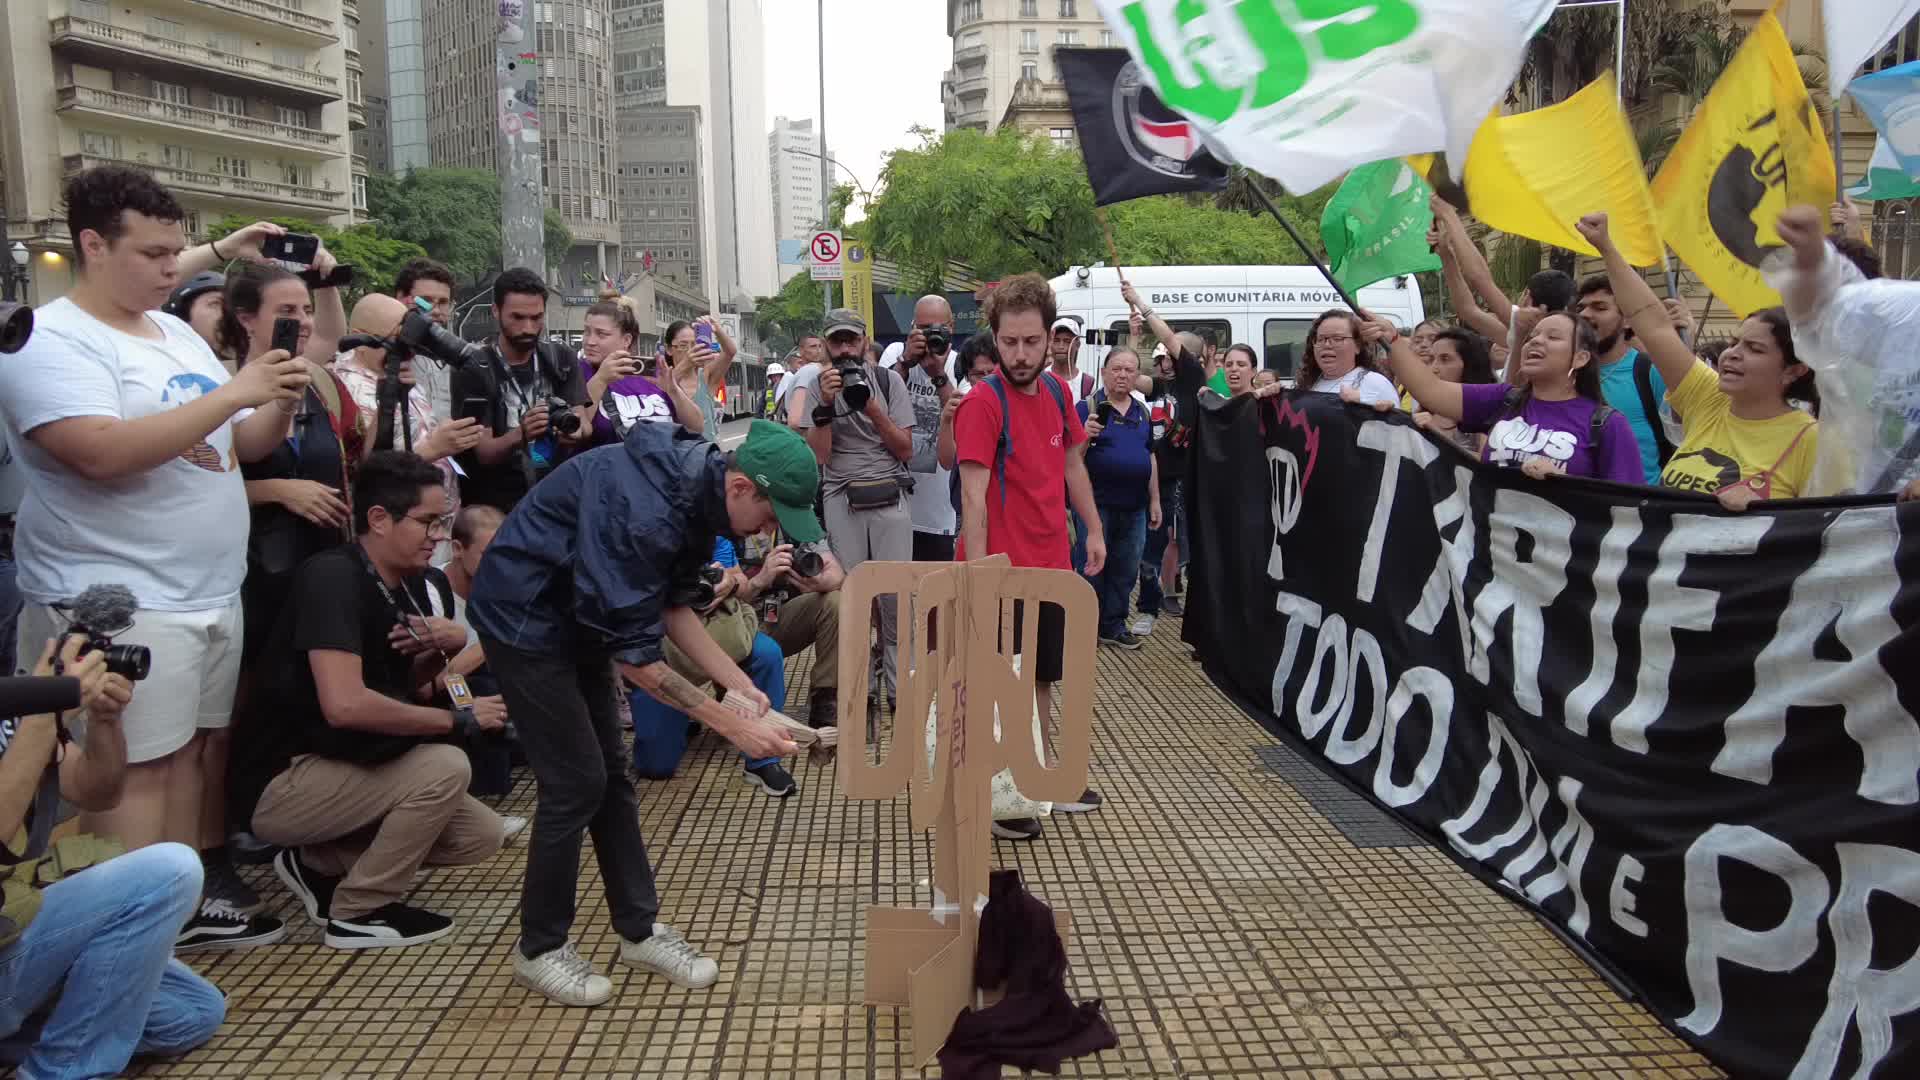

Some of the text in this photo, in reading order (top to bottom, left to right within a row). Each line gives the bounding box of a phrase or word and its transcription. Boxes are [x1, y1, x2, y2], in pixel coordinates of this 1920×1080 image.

[1151, 289, 1345, 304] BASE COMUNITÁRIA MÓVE
[1272, 592, 1454, 808] TODO
[1609, 853, 1649, 938] E
[1356, 420, 1920, 806] TARIFA
